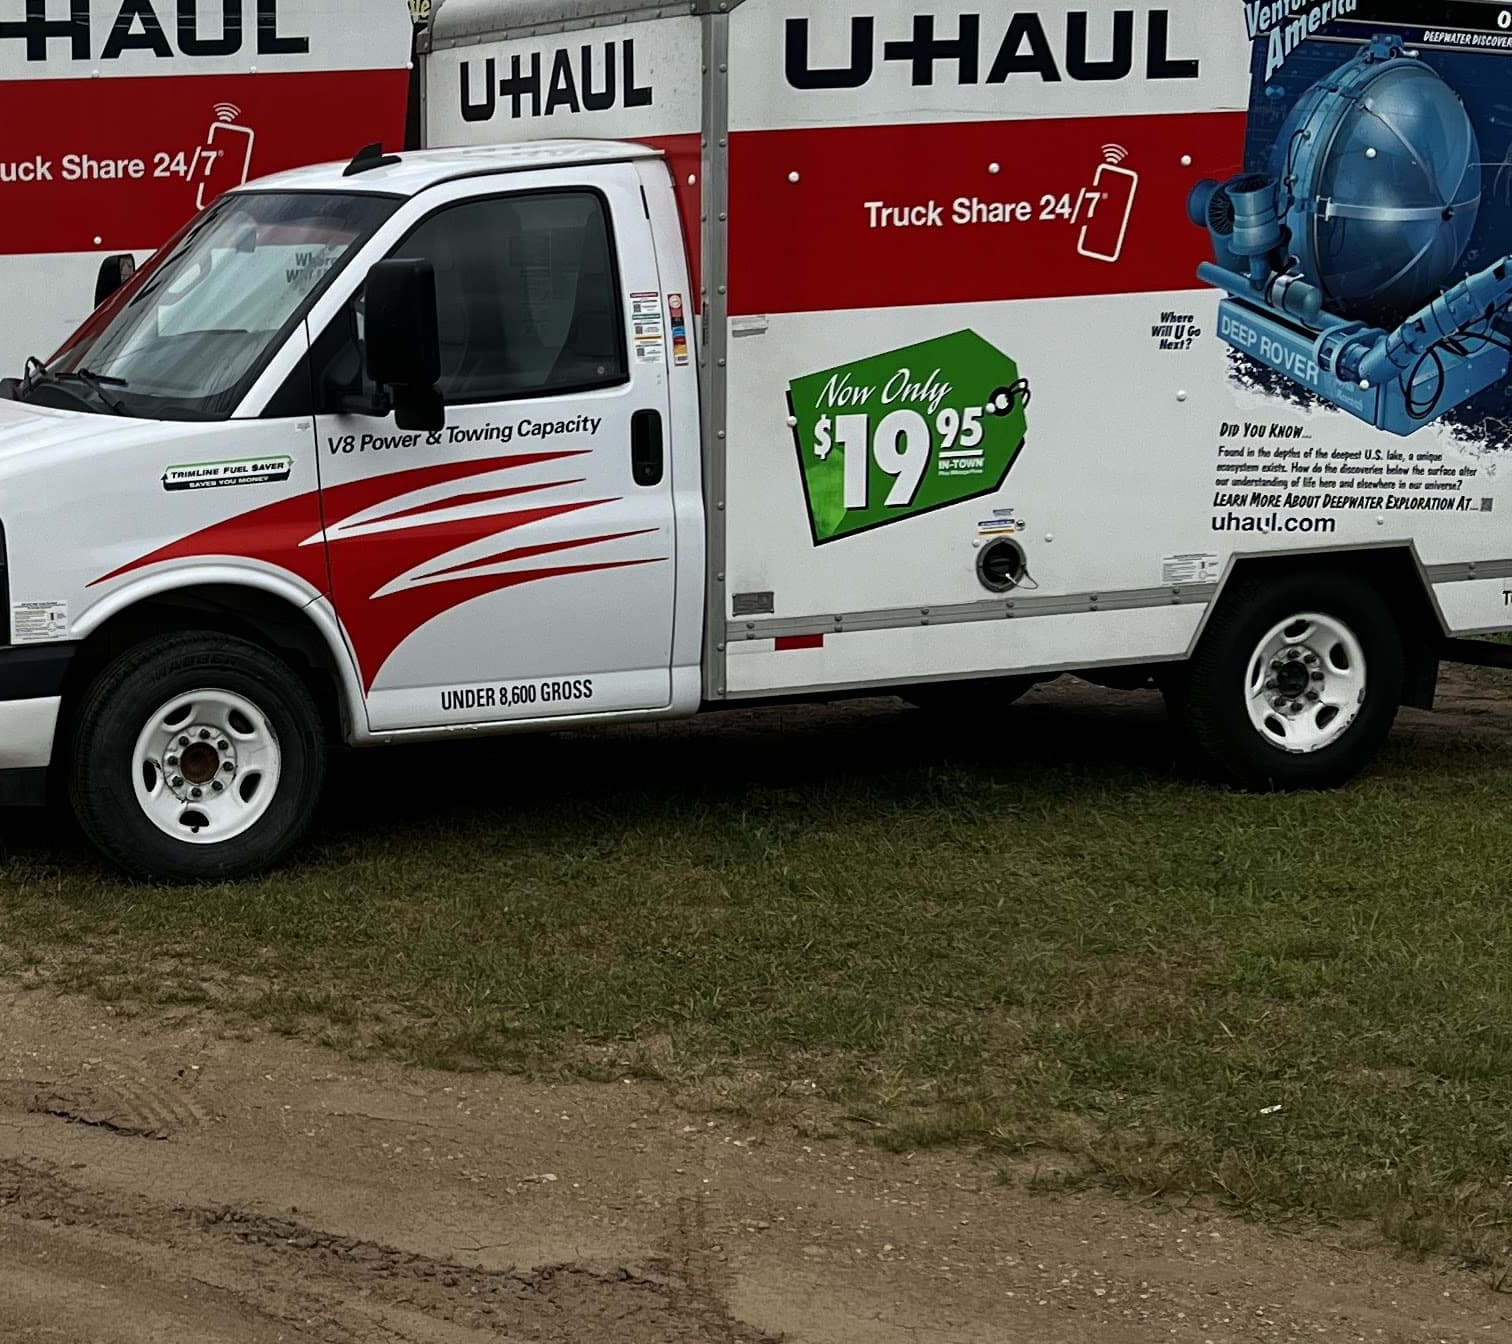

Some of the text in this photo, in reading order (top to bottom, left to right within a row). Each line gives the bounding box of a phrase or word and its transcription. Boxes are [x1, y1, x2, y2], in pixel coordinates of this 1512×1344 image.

[1497, 10, 1512, 29] O
[1423, 30, 1512, 48] DEEPWATER DISCOVER
[785, 9, 1200, 91] U-HAUL
[459, 39, 653, 123] U-HAUL
[61, 153, 144, 182] Share
[153, 145, 217, 182] 24/7
[864, 187, 1101, 228] Truck Share 24/7
[1159, 312, 1194, 324] Where
[1151, 324, 1202, 340] Will U Go
[1159, 338, 1193, 351] Next?
[1221, 315, 1321, 385] DEEP ROVER
[815, 368, 953, 415] Now Only
[327, 414, 602, 455] V8 Power & Towing Capacity
[1220, 422, 1240, 437] DID
[1244, 422, 1266, 437] YOU
[1218, 445, 1245, 457] Found
[1247, 446, 1255, 457] in
[1258, 446, 1271, 458] the
[1273, 447, 1301, 460] depths
[1304, 447, 1314, 458] of
[1315, 448, 1328, 459] the
[1331, 448, 1361, 461] deepest
[1364, 449, 1383, 461] U.S.
[1416, 450, 1443, 463] unique
[171, 462, 284, 479] TRIMLINE FUEL SAVER
[938, 457, 985, 470] IN-TOWN
[1216, 462, 1259, 474] ecosystem
[1291, 461, 1310, 473] How
[1312, 463, 1322, 474] do
[1325, 463, 1337, 474] the
[1339, 463, 1384, 475] discoveries
[1386, 464, 1409, 475] below
[1412, 464, 1425, 476] the
[1427, 465, 1456, 477] surface
[218, 478, 237, 486] YOU
[1215, 476, 1463, 491] our understanding of life here and elsewhere in our universe?
[1213, 492, 1248, 507] LEARN
[1249, 492, 1282, 508] MORE
[1283, 492, 1322, 509] ABOUT
[1322, 493, 1384, 509] DEEPWATER
[1385, 494, 1455, 511] EXPLORATION
[1211, 512, 1336, 533] uhaul.com
[1502, 590, 1512, 606] T
[441, 679, 593, 711] UNDER 8,600 GROSS
